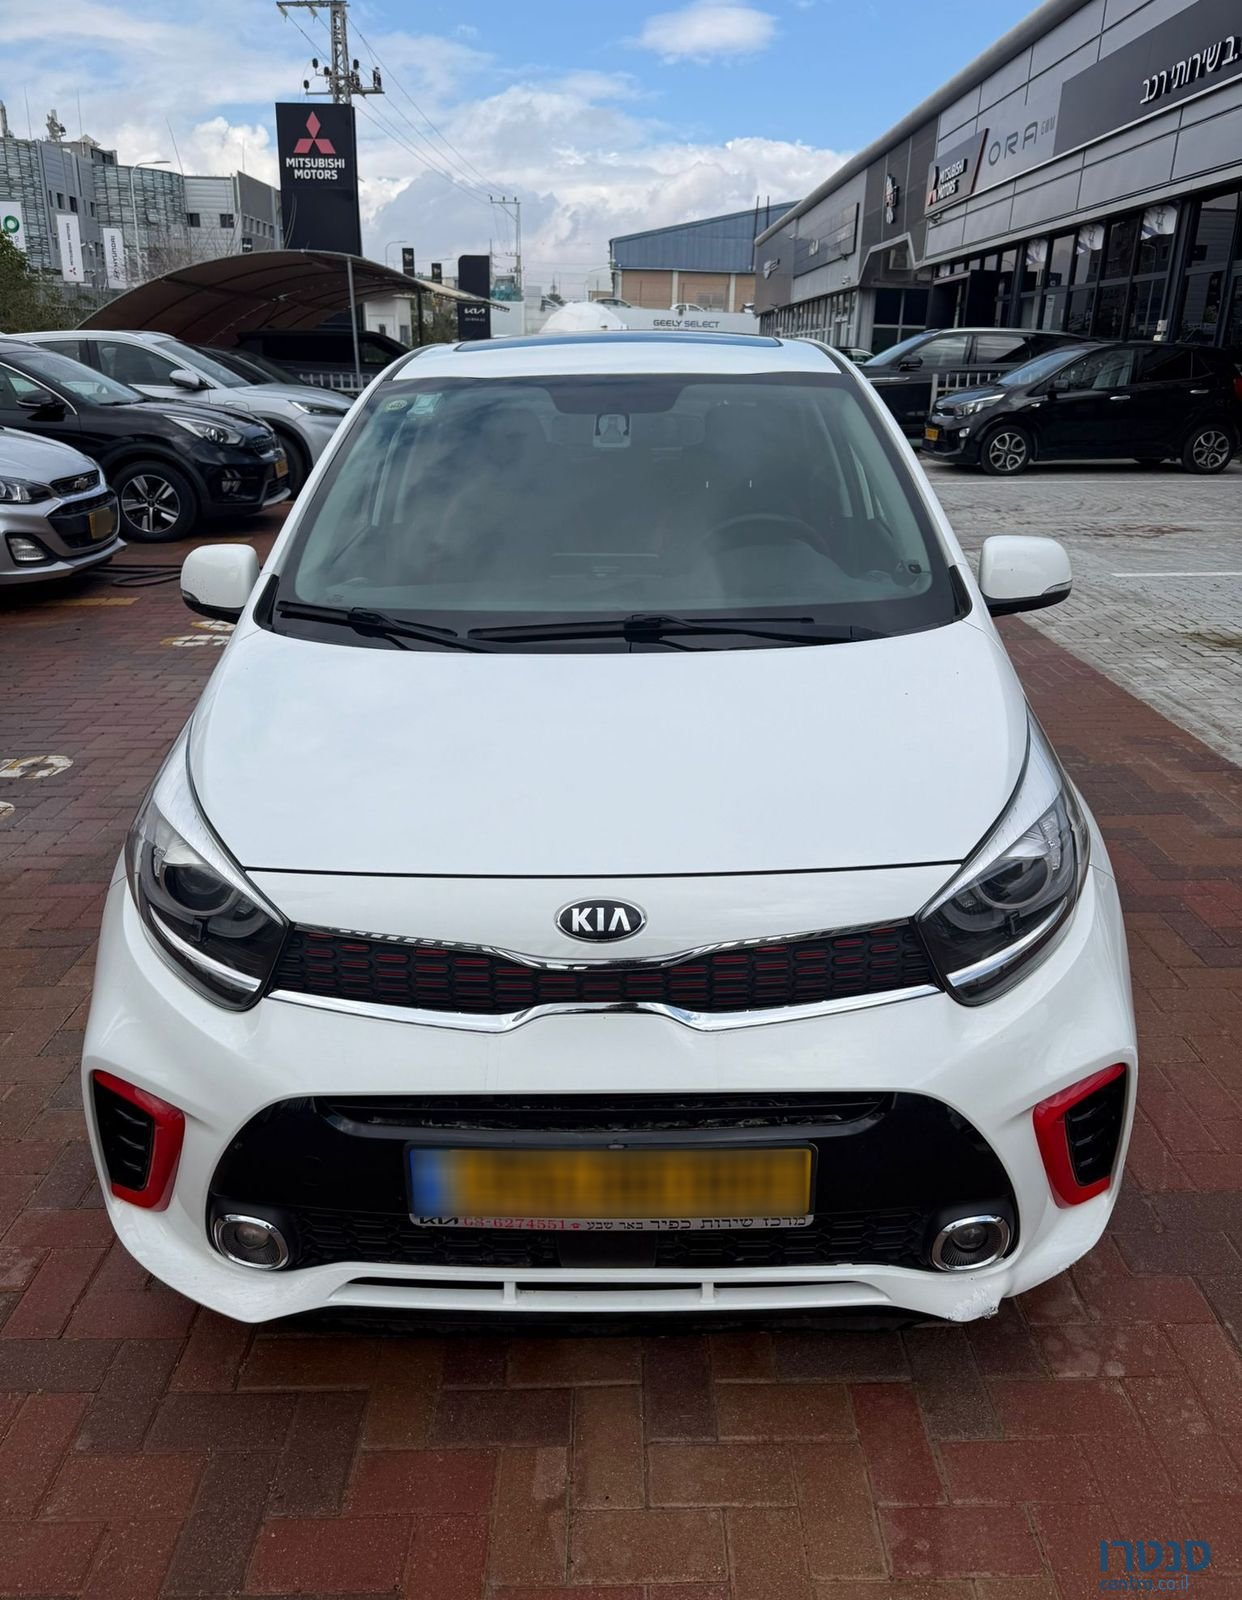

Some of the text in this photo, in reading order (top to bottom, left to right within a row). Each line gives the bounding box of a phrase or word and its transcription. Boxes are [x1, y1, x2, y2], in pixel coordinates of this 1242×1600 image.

[1171, 41, 1222, 89] שירותי
[1140, 70, 1167, 104] רכב
[988, 121, 1038, 166] ORA
[285, 157, 346, 169] MITSUBISHI
[293, 169, 339, 180] MOTORS
[653, 319, 682, 328] GEELY
[684, 320, 720, 329] SELECT
[571, 907, 632, 932] KIA
[419, 1216, 459, 1225] KIA
[586, 1221, 614, 1231] שבע
[618, 1221, 643, 1230] באר
[650, 1219, 692, 1230] כפיר
[701, 1217, 754, 1229] שירות
[763, 1216, 807, 1227] מרכז
